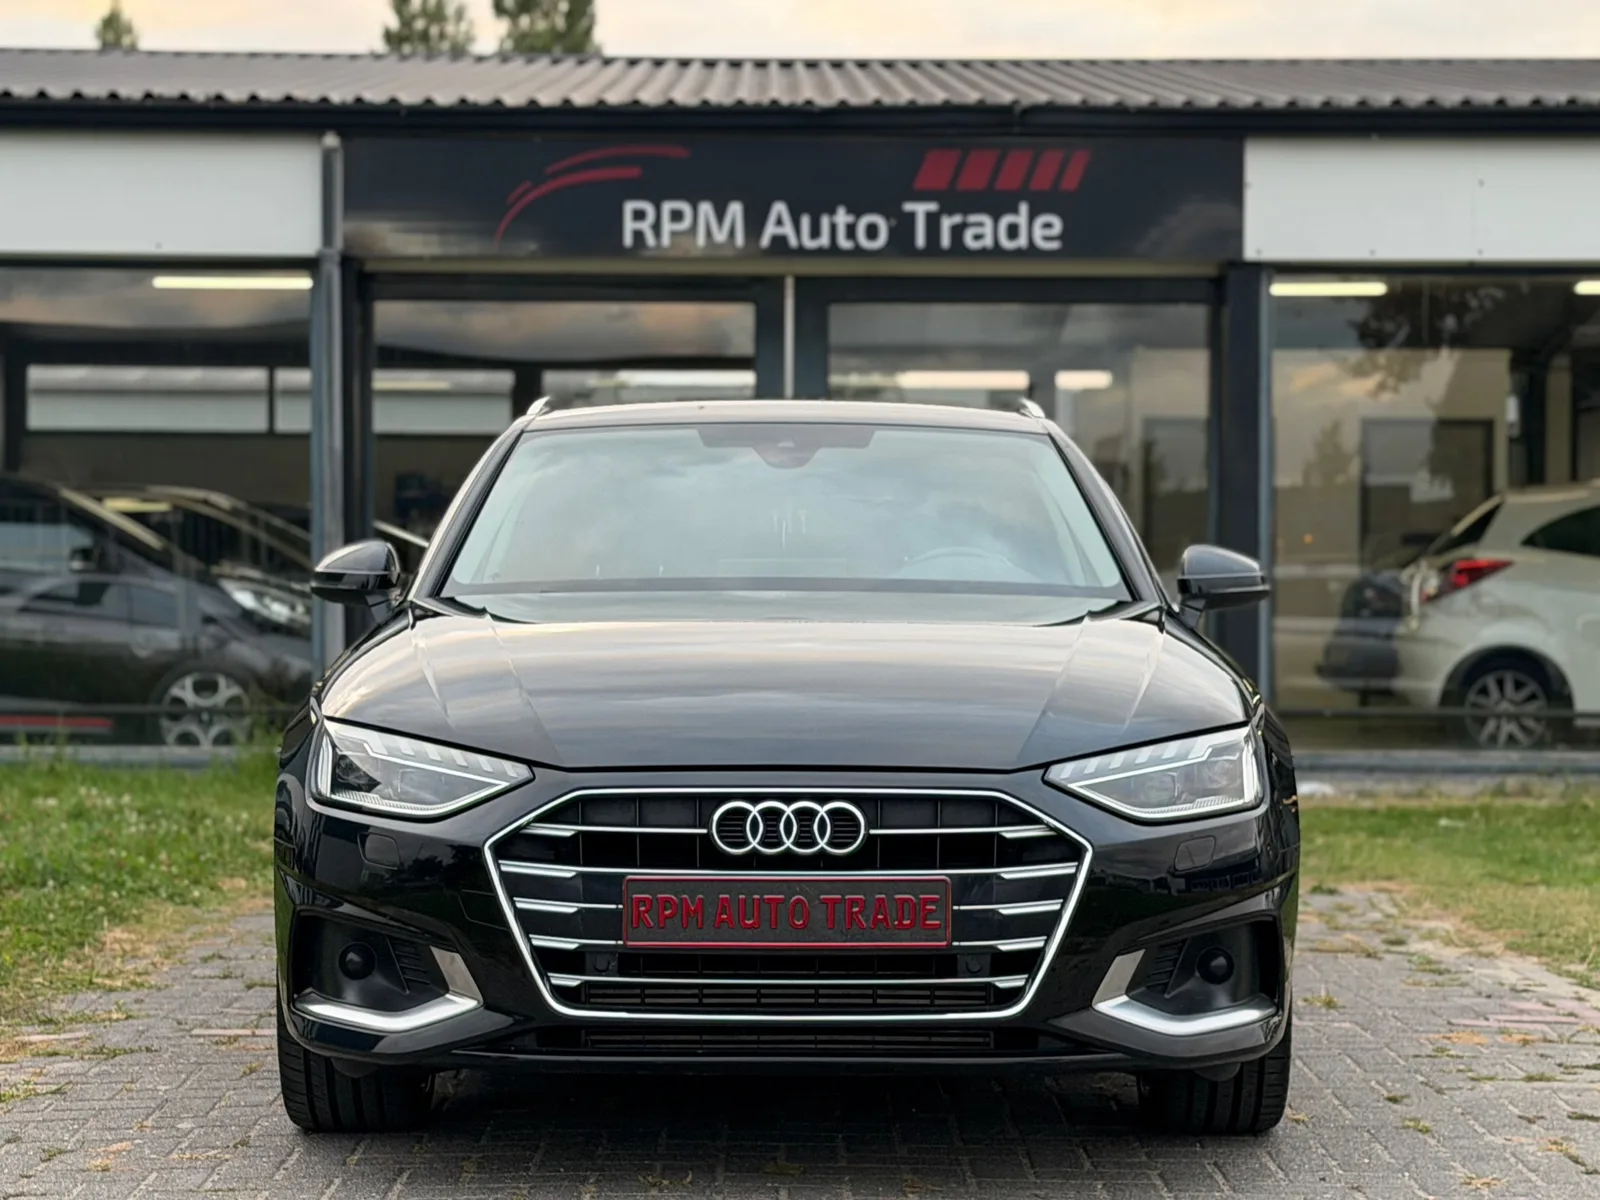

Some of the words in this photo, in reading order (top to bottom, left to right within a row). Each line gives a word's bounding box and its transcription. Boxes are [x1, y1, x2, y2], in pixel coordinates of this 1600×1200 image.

[622, 200, 745, 249] RPM
[760, 200, 888, 250] Auto
[902, 201, 1064, 250] Trade
[631, 894, 704, 929] RPM
[714, 894, 810, 930] AUTO
[819, 894, 942, 930] TRADE
